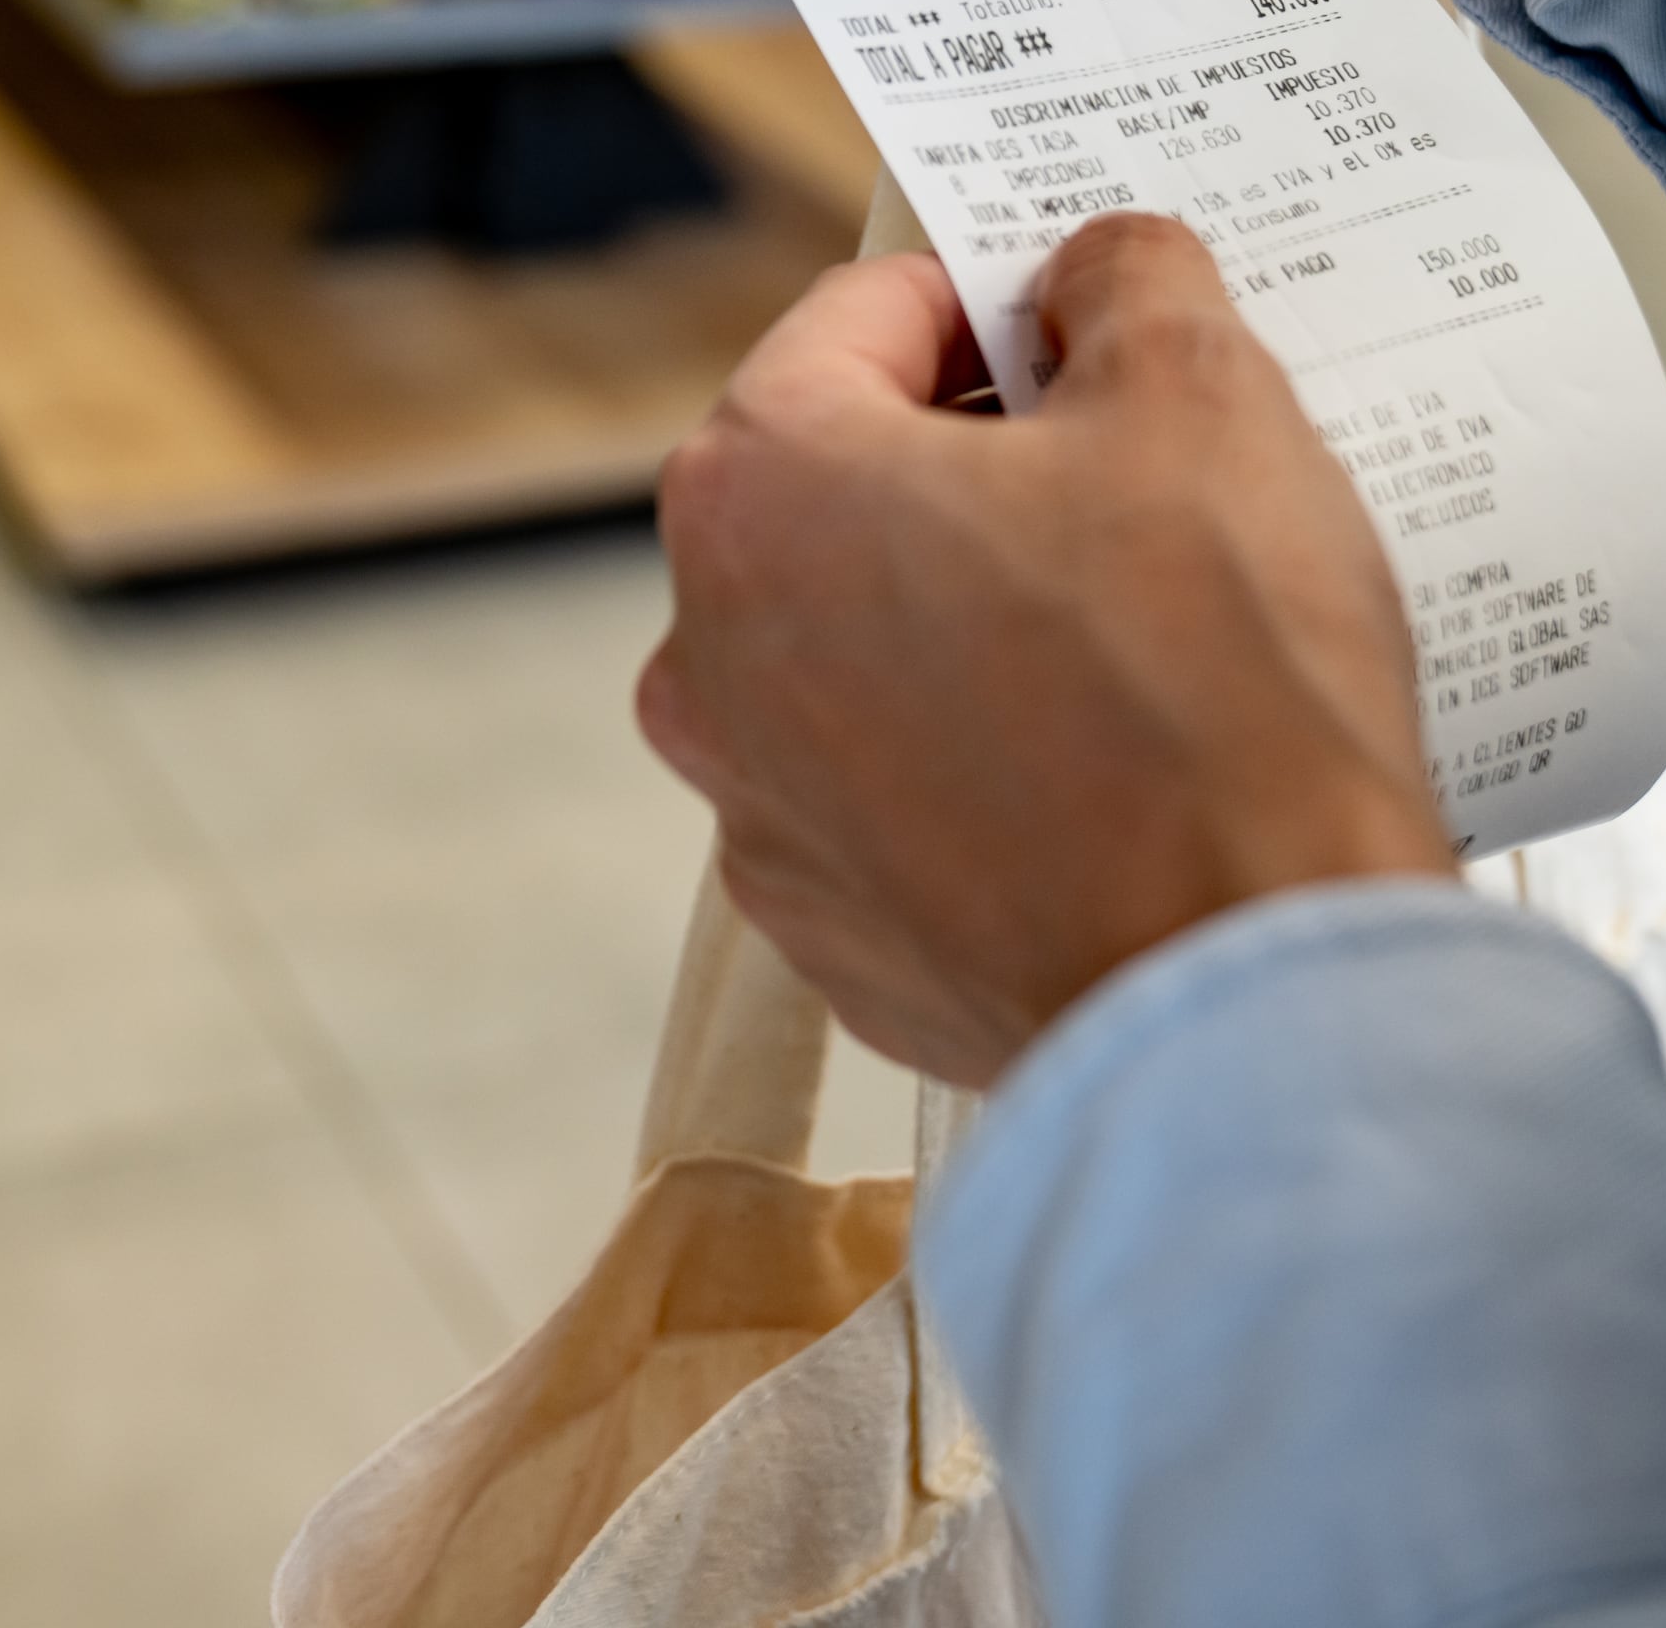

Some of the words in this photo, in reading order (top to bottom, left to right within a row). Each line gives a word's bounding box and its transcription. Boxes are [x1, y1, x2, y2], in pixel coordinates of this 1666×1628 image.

[841, 14, 899, 38] TOTAL
[855, 44, 925, 84] TOTAL
[924, 42, 947, 79] A
[942, 31, 1014, 76] PAGAR
[913, 144, 983, 166] TARIFA
[1028, 130, 1079, 155] TASA
[1119, 100, 1209, 138] BASE/IMP
[1265, 61, 1360, 101] IMPUESTO
[991, 81, 1153, 130] DISCRIMINACION
[1157, 75, 1186, 96] DE
[1192, 48, 1297, 90] IMPUESTOS
[1158, 124, 1241, 161] 129.630
[1305, 87, 1376, 122] 10.370
[968, 204, 1023, 225] TOTAL
[1032, 183, 1134, 219] IMPUESTOS
[1323, 112, 1396, 146] 10.370
[1192, 190, 1231, 215] 19%
[1240, 182, 1266, 201] es
[1272, 169, 1313, 192] IVA
[1320, 164, 1334, 180] y
[1342, 152, 1369, 171] el
[1374, 141, 1402, 161] 0%
[1411, 133, 1436, 151] es
[1232, 198, 1319, 234] Consumo
[1245, 273, 1274, 294] DE
[1280, 252, 1335, 282] PAGO
[1418, 234, 1500, 274] 150.000
[1448, 263, 1519, 299] 10.000
[1371, 402, 1400, 430] DE
[1408, 390, 1445, 418] IVA
[1421, 429, 1446, 454] DE
[1457, 414, 1494, 443] IVA
[1396, 488, 1495, 537] INCLUIDOS
[1445, 560, 1510, 597] COMPRA
[1483, 578, 1566, 625] SOFTWARE
[1576, 569, 1597, 596] DE
[1508, 616, 1569, 654] GLOBAL
[1579, 601, 1610, 630] SAS
[1471, 675, 1500, 704] ICG
[1510, 642, 1590, 689] SOFTWARE
[1473, 718, 1556, 765] CLIENTES
